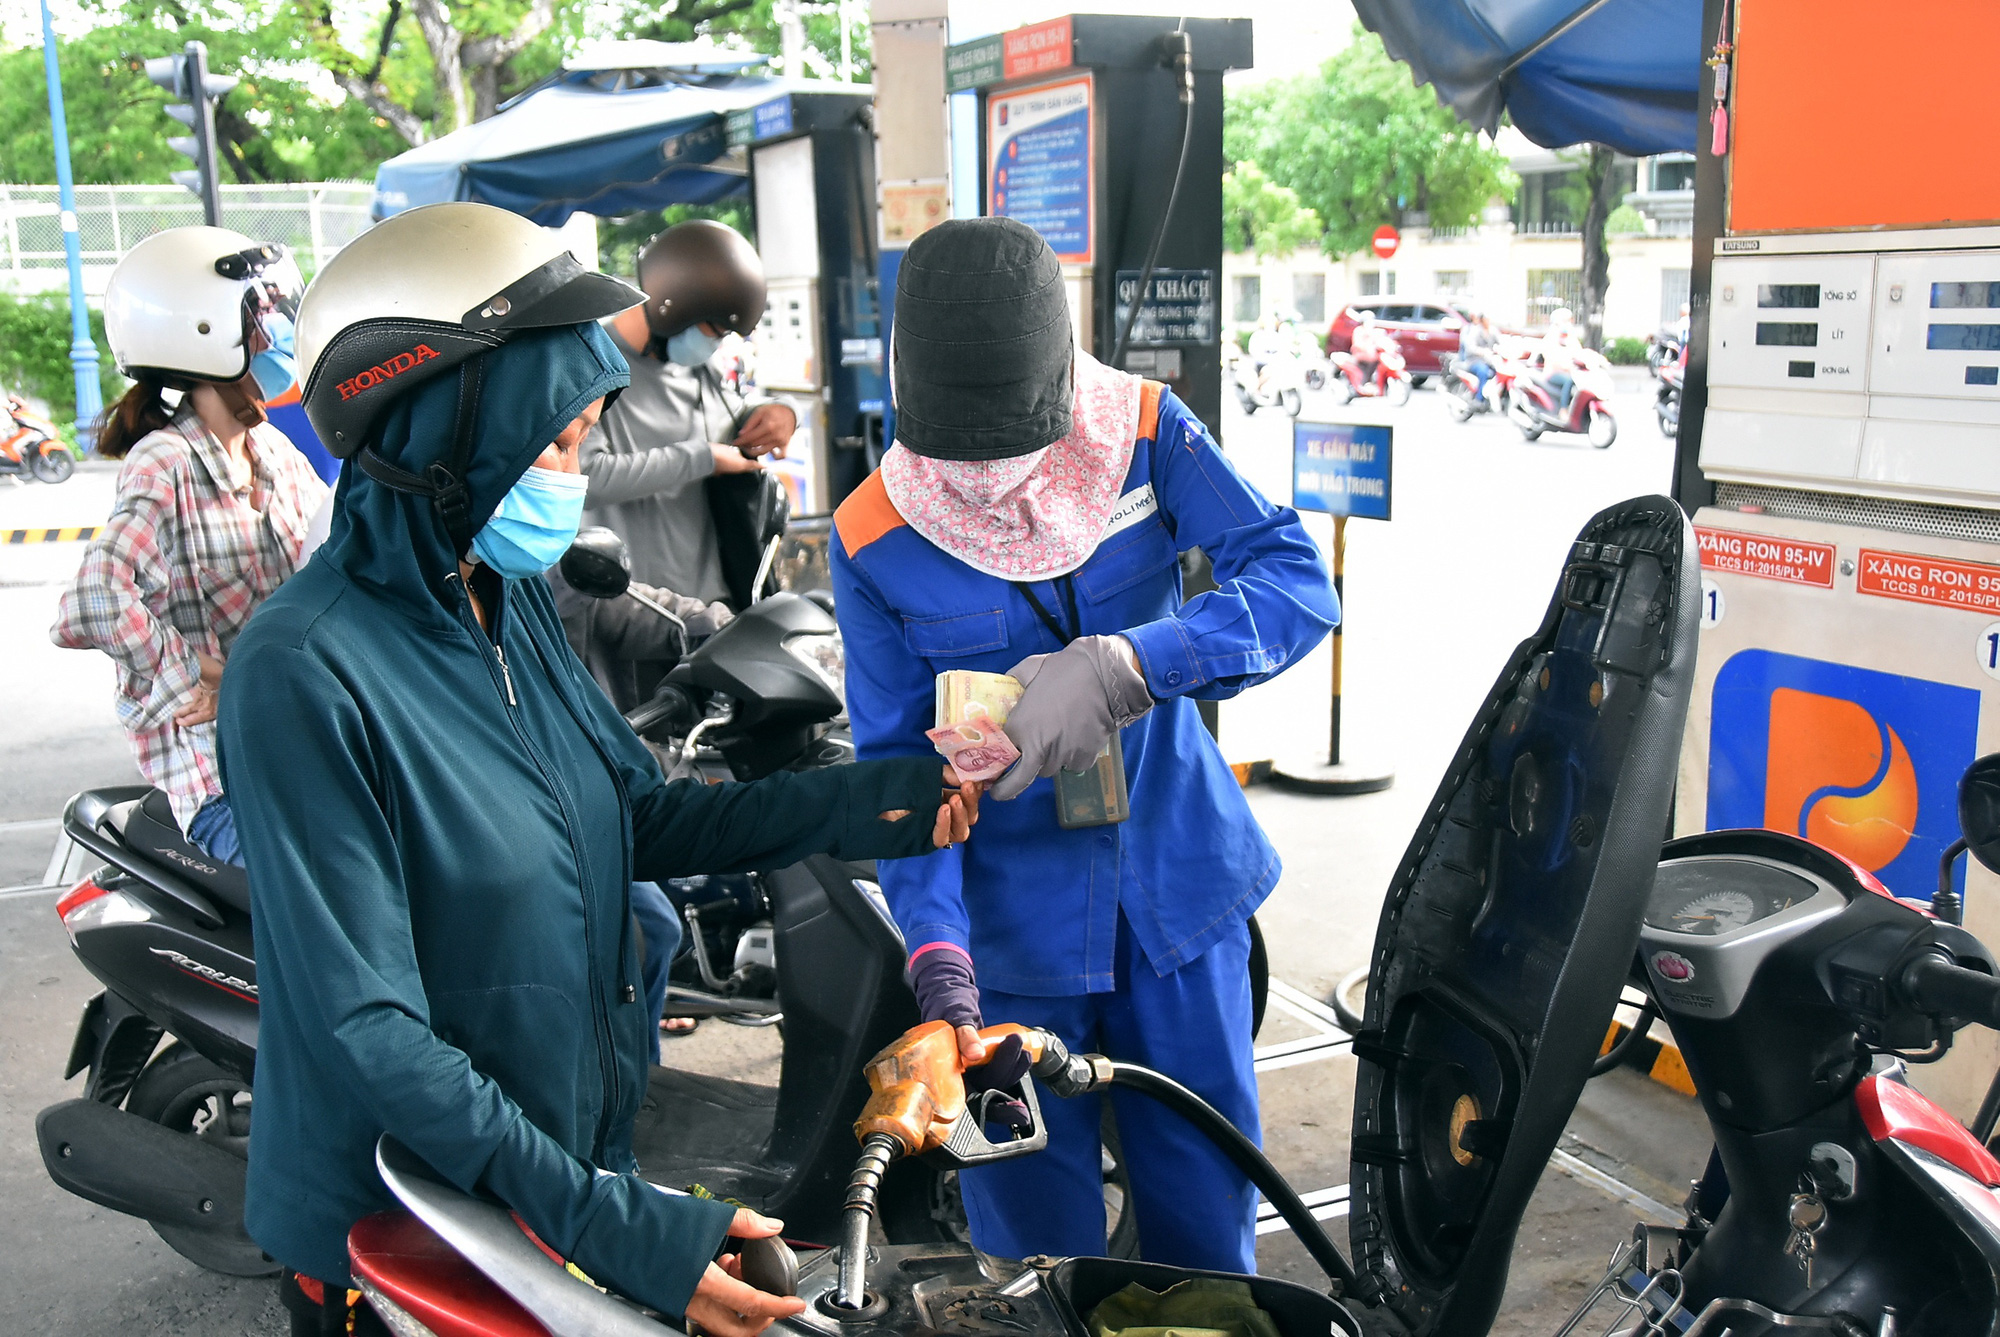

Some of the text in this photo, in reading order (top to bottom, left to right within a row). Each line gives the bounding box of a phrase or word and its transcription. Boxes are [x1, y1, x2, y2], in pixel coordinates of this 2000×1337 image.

[1725, 240, 1758, 250] TATSUNO
[1156, 274, 1210, 298] KHÁCH
[1831, 328, 1844, 340] LÍT
[335, 343, 441, 402] HONDA
[1307, 439, 1322, 459] XE
[1349, 441, 1376, 462] MÁY
[1346, 475, 1384, 498] TRONG
[1698, 532, 1825, 567] XĂNG RON 95-IV
[1713, 554, 1741, 570] TCCS
[1867, 559, 1922, 580] XĂNG
[1928, 568, 1972, 588] RON
[1881, 578, 1918, 594] TCCS
[1920, 585, 1936, 598] 01
[154, 847, 217, 875] ACRUZO
